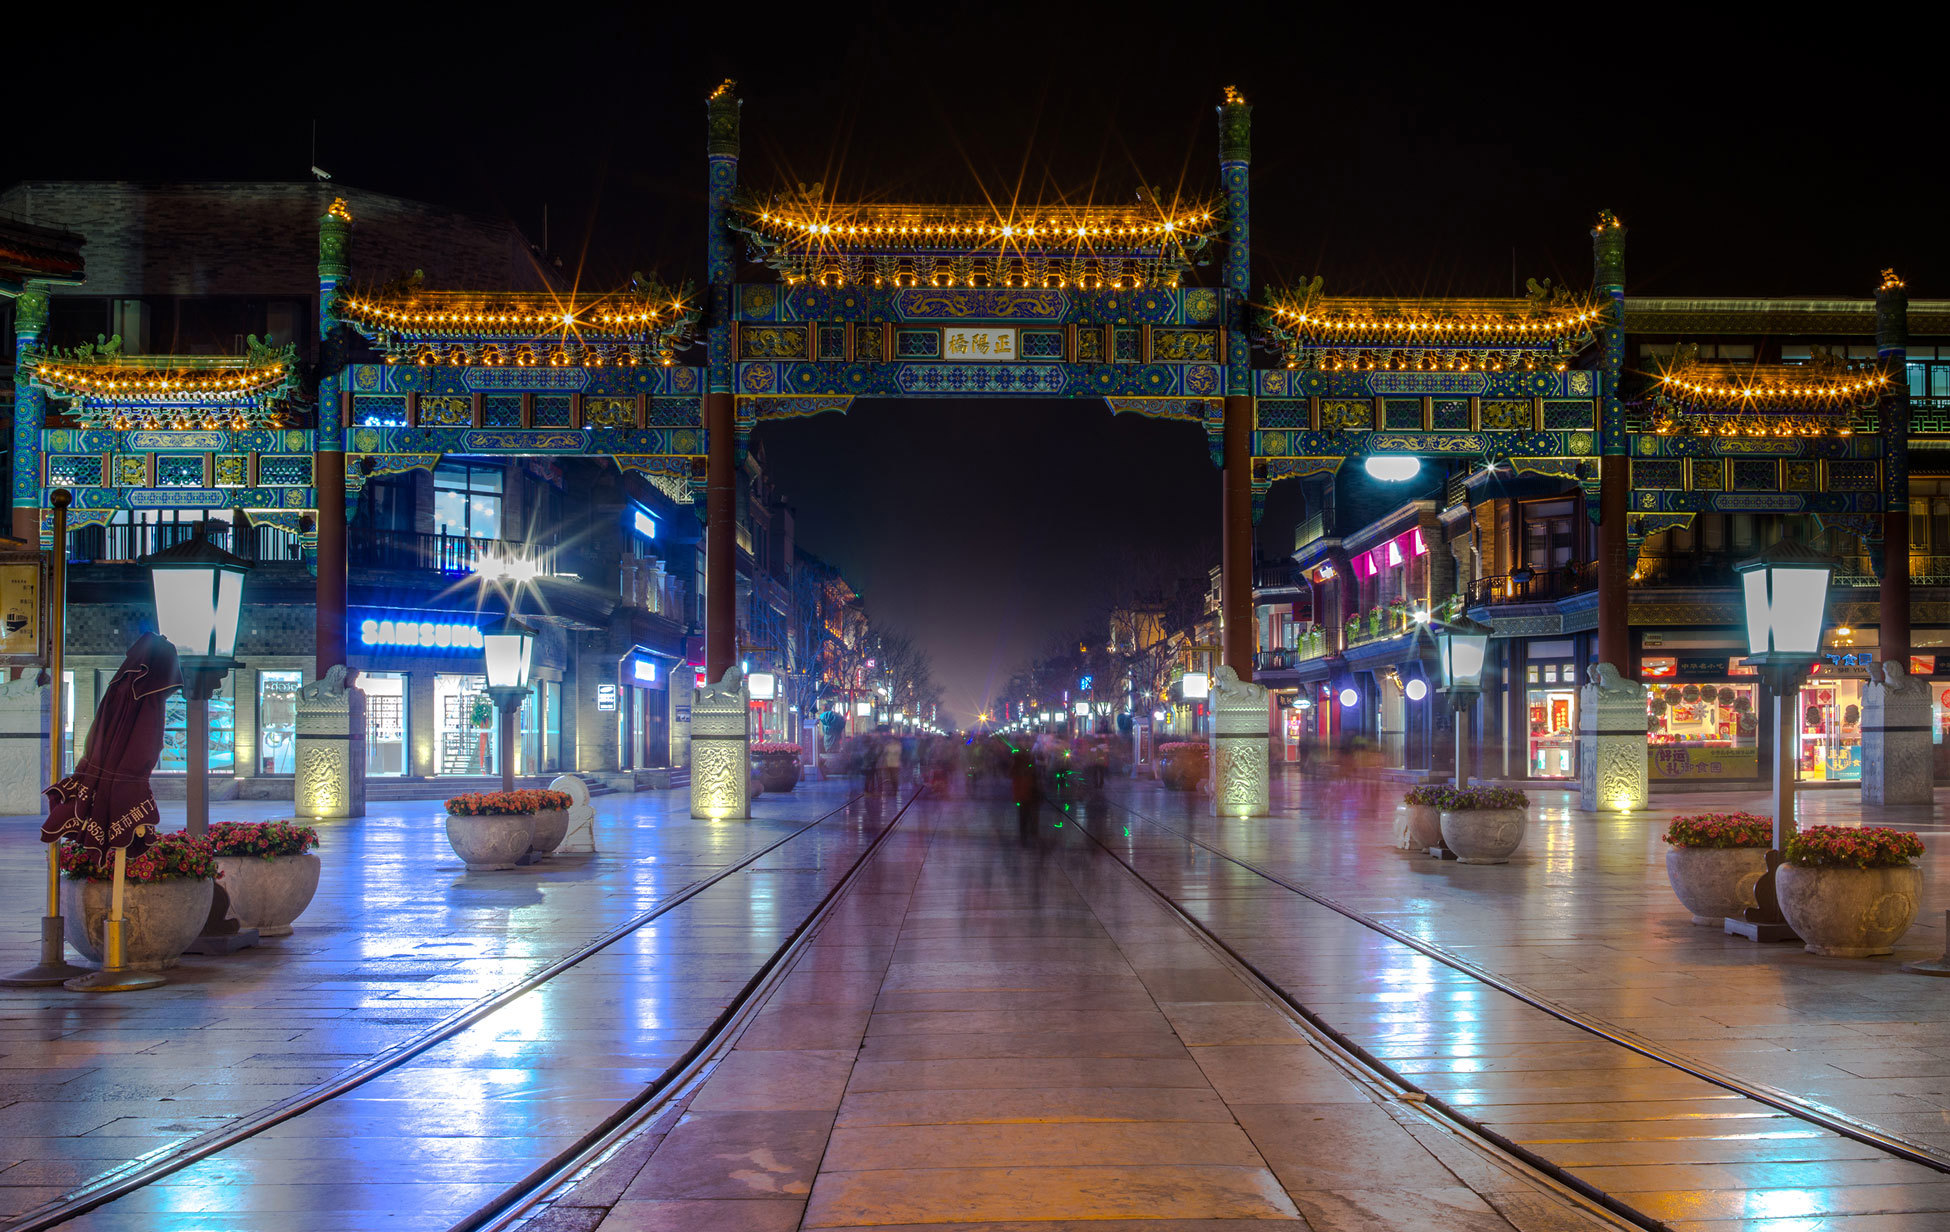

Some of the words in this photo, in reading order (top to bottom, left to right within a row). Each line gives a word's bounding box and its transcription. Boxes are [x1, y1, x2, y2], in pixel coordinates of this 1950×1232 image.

[948, 333, 1012, 354] 正陽橋
[361, 619, 484, 648] SAMSUNG
